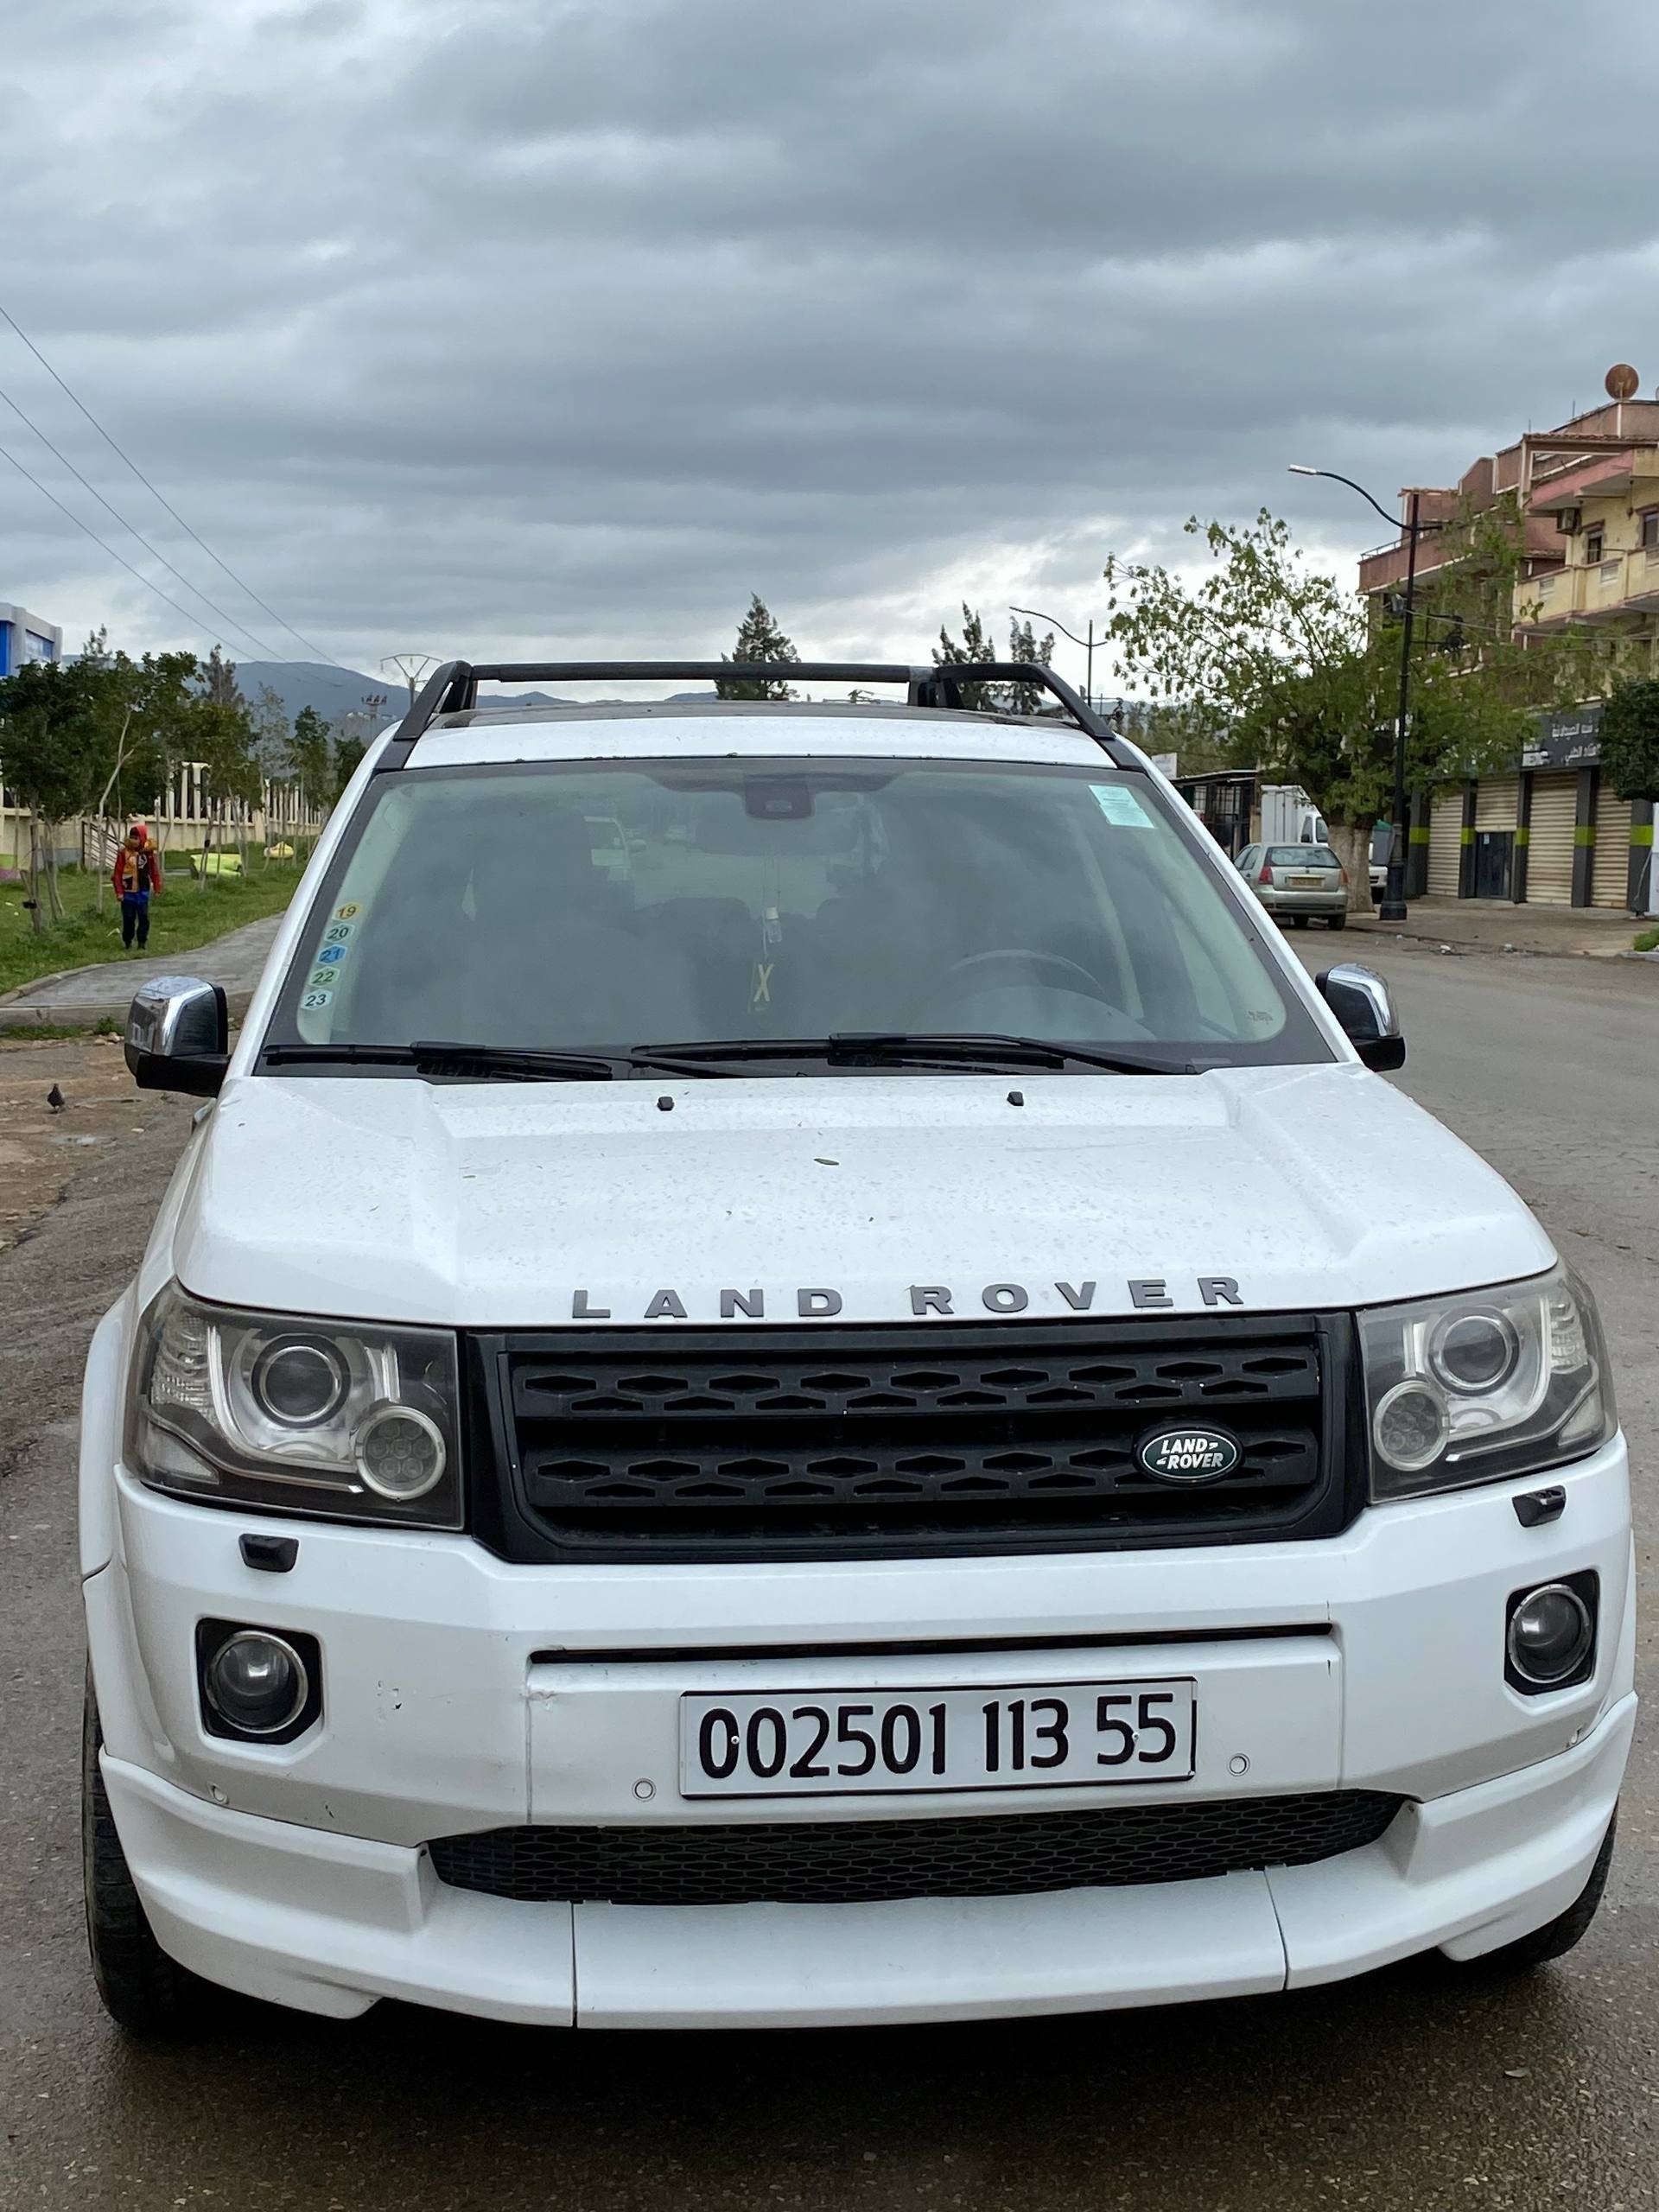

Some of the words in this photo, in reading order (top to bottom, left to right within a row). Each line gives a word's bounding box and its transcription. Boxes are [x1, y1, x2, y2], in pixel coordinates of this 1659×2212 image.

[337, 906, 357, 918] 19
[327, 927, 349, 941] 20
[320, 950, 340, 963] 21
[312, 970, 334, 984] 22
[305, 994, 327, 1007] 23
[572, 1287, 843, 1319] LAND
[910, 1276, 1245, 1315] ROVER
[699, 1702, 947, 1779] 002501
[982, 1697, 1070, 1772] 113
[1096, 1693, 1176, 1765] 55
